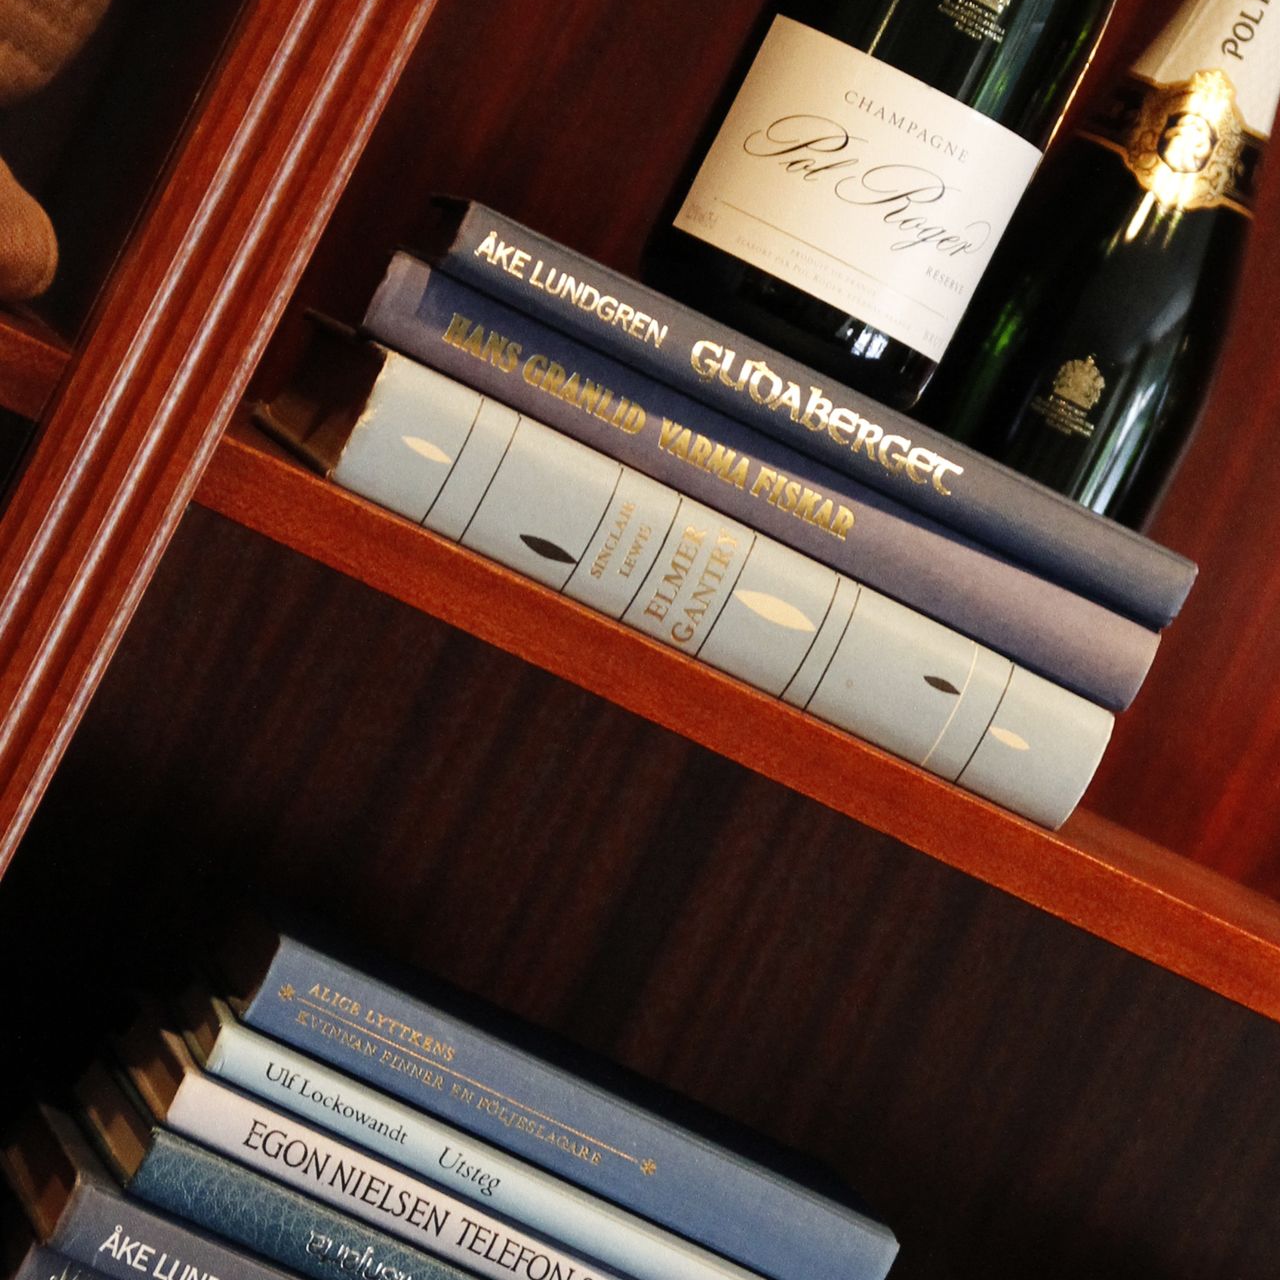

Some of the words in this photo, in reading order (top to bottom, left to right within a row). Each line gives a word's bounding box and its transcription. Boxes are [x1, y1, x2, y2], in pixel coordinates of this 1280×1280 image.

[1221, 10, 1264, 60] POL
[844, 89, 969, 164] CHAMPAGNE
[743, 114, 868, 181] Pol
[835, 164, 991, 257] Roger
[474, 231, 531, 280] ÅKE
[529, 260, 668, 348] LUNDGREN
[442, 312, 523, 374] HANS
[522, 354, 646, 435] GRANLID
[657, 417, 750, 490] VARMA
[750, 466, 856, 542] FISKAR
[589, 501, 637, 580] SINCLAIR
[643, 525, 707, 622] ELMER
[670, 527, 738, 643] GANTRY
[308, 982, 360, 1017] ALICE
[366, 1007, 457, 1062] LYTTKENS
[265, 1061, 300, 1091] Ulf
[299, 1078, 409, 1146] Lockowandt
[296, 1011, 377, 1058] KVINNAN
[380, 1048, 445, 1092] FINNER
[452, 1082, 474, 1105] EN
[476, 1095, 603, 1166] FÖLJESLAGARE
[242, 1119, 330, 1185] EGON
[328, 1160, 452, 1238] NIELSEN
[438, 1146, 502, 1197] Utsteg
[99, 1225, 155, 1272] ÅKE
